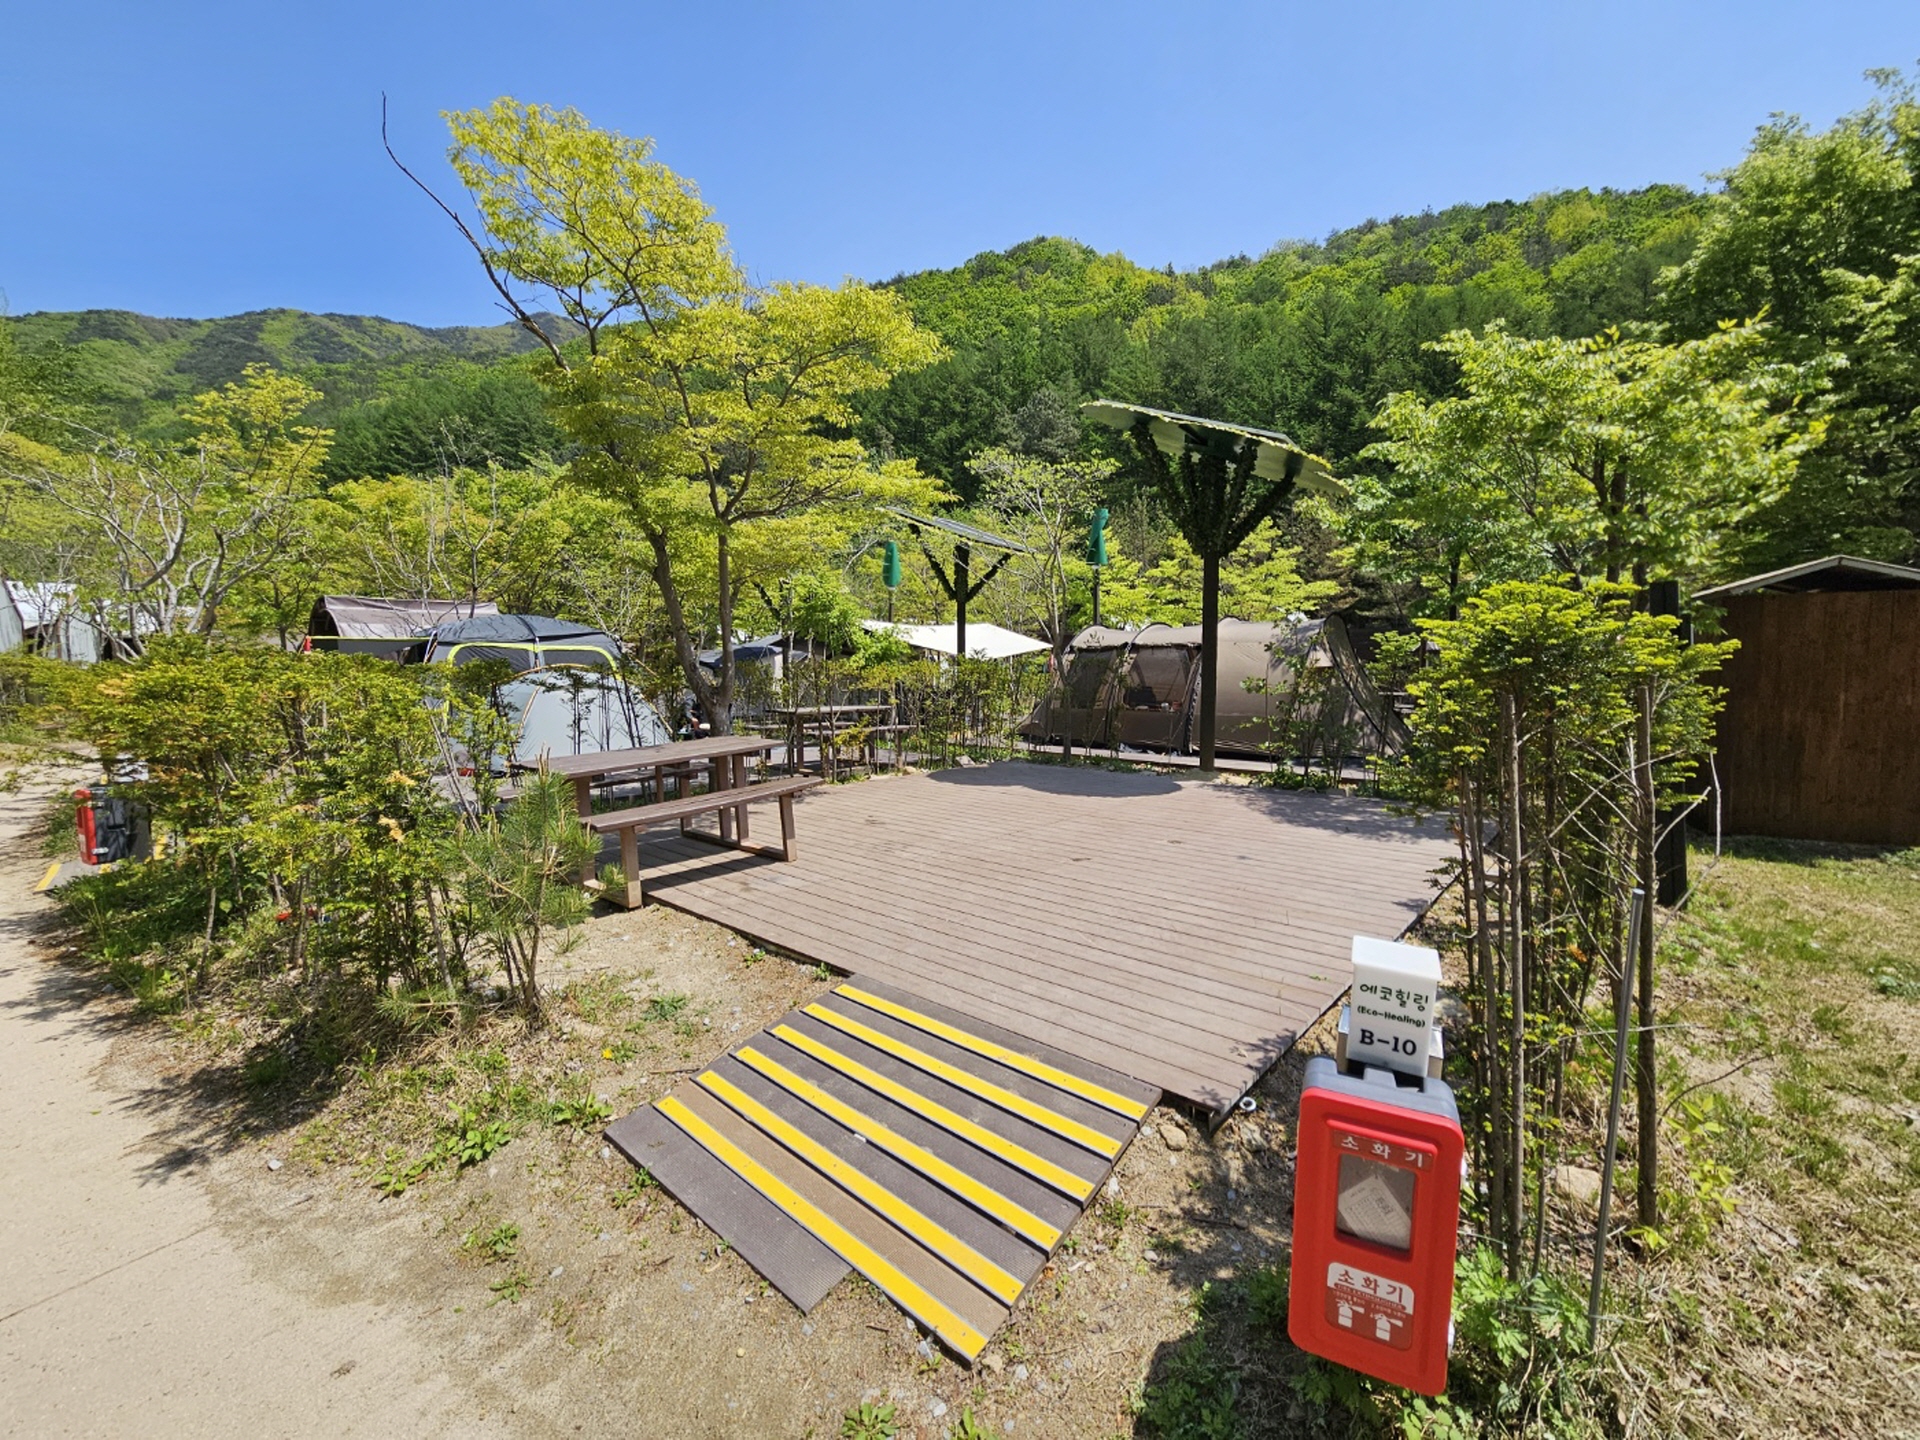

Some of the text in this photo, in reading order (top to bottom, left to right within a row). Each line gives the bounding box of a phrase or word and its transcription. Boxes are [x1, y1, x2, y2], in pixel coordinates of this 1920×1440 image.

[1359, 983, 1428, 1012] 에코힐링
[1357, 1005, 1426, 1028] (Eco-Healing)
[1359, 1028, 1417, 1056] B-10
[1341, 1136, 1423, 1168] 소화기
[1338, 1269, 1403, 1303] 소화기
